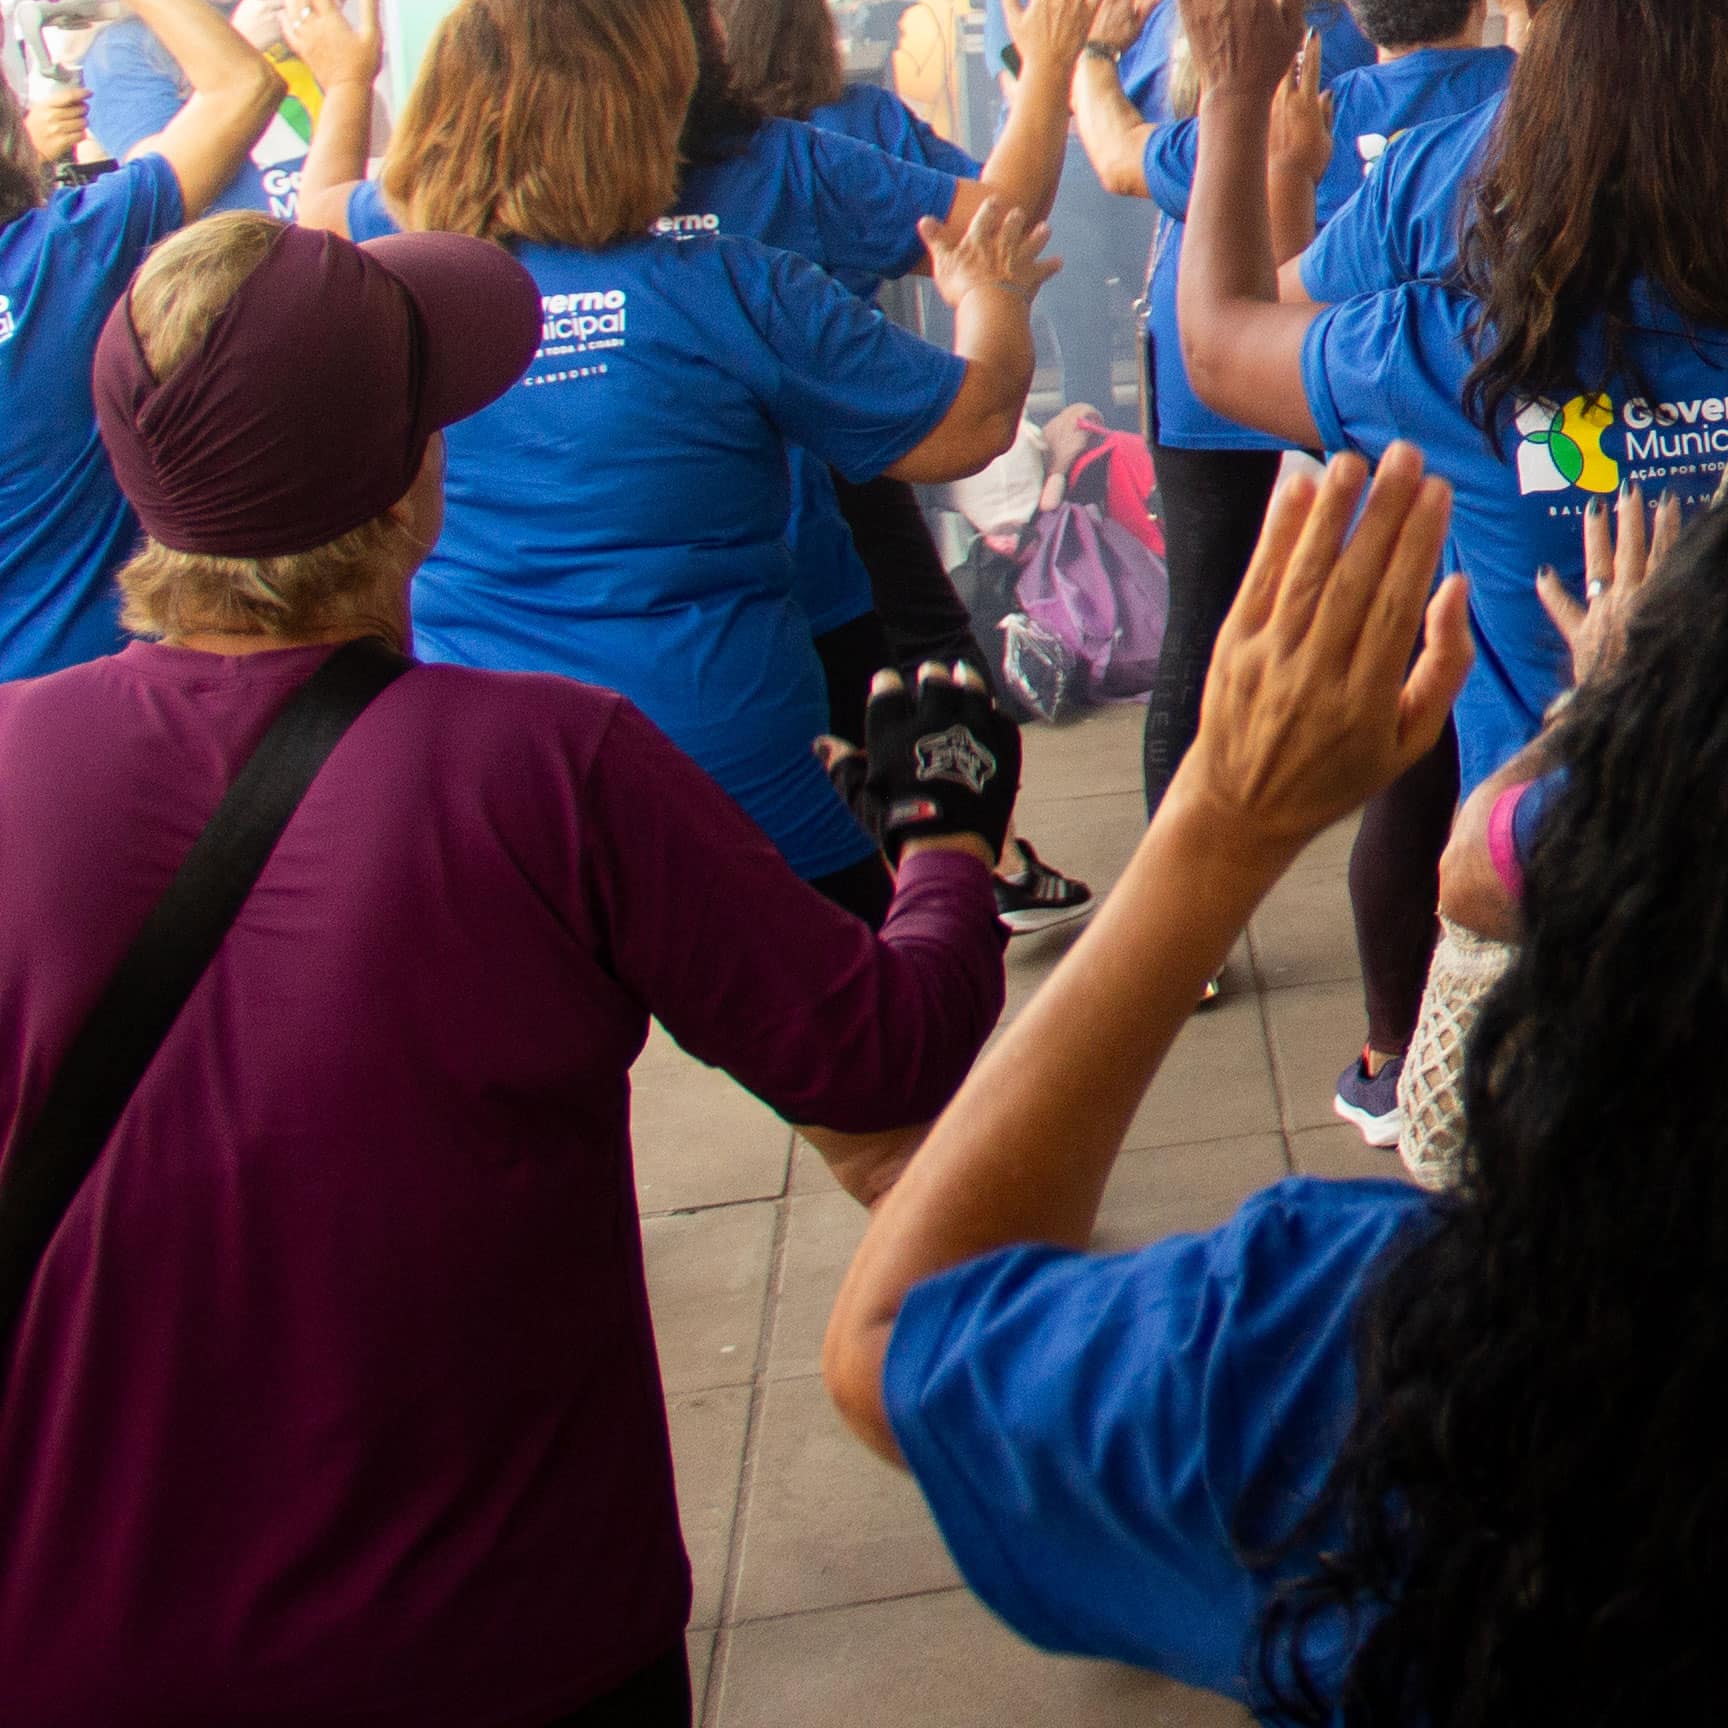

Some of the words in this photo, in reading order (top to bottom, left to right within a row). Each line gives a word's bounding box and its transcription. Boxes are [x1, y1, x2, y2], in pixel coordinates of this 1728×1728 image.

[655, 213, 719, 232] erno
[1630, 464, 1667, 480] AÇÃO
[1670, 465, 1697, 476] POR
[1701, 461, 1728, 473] TOD
